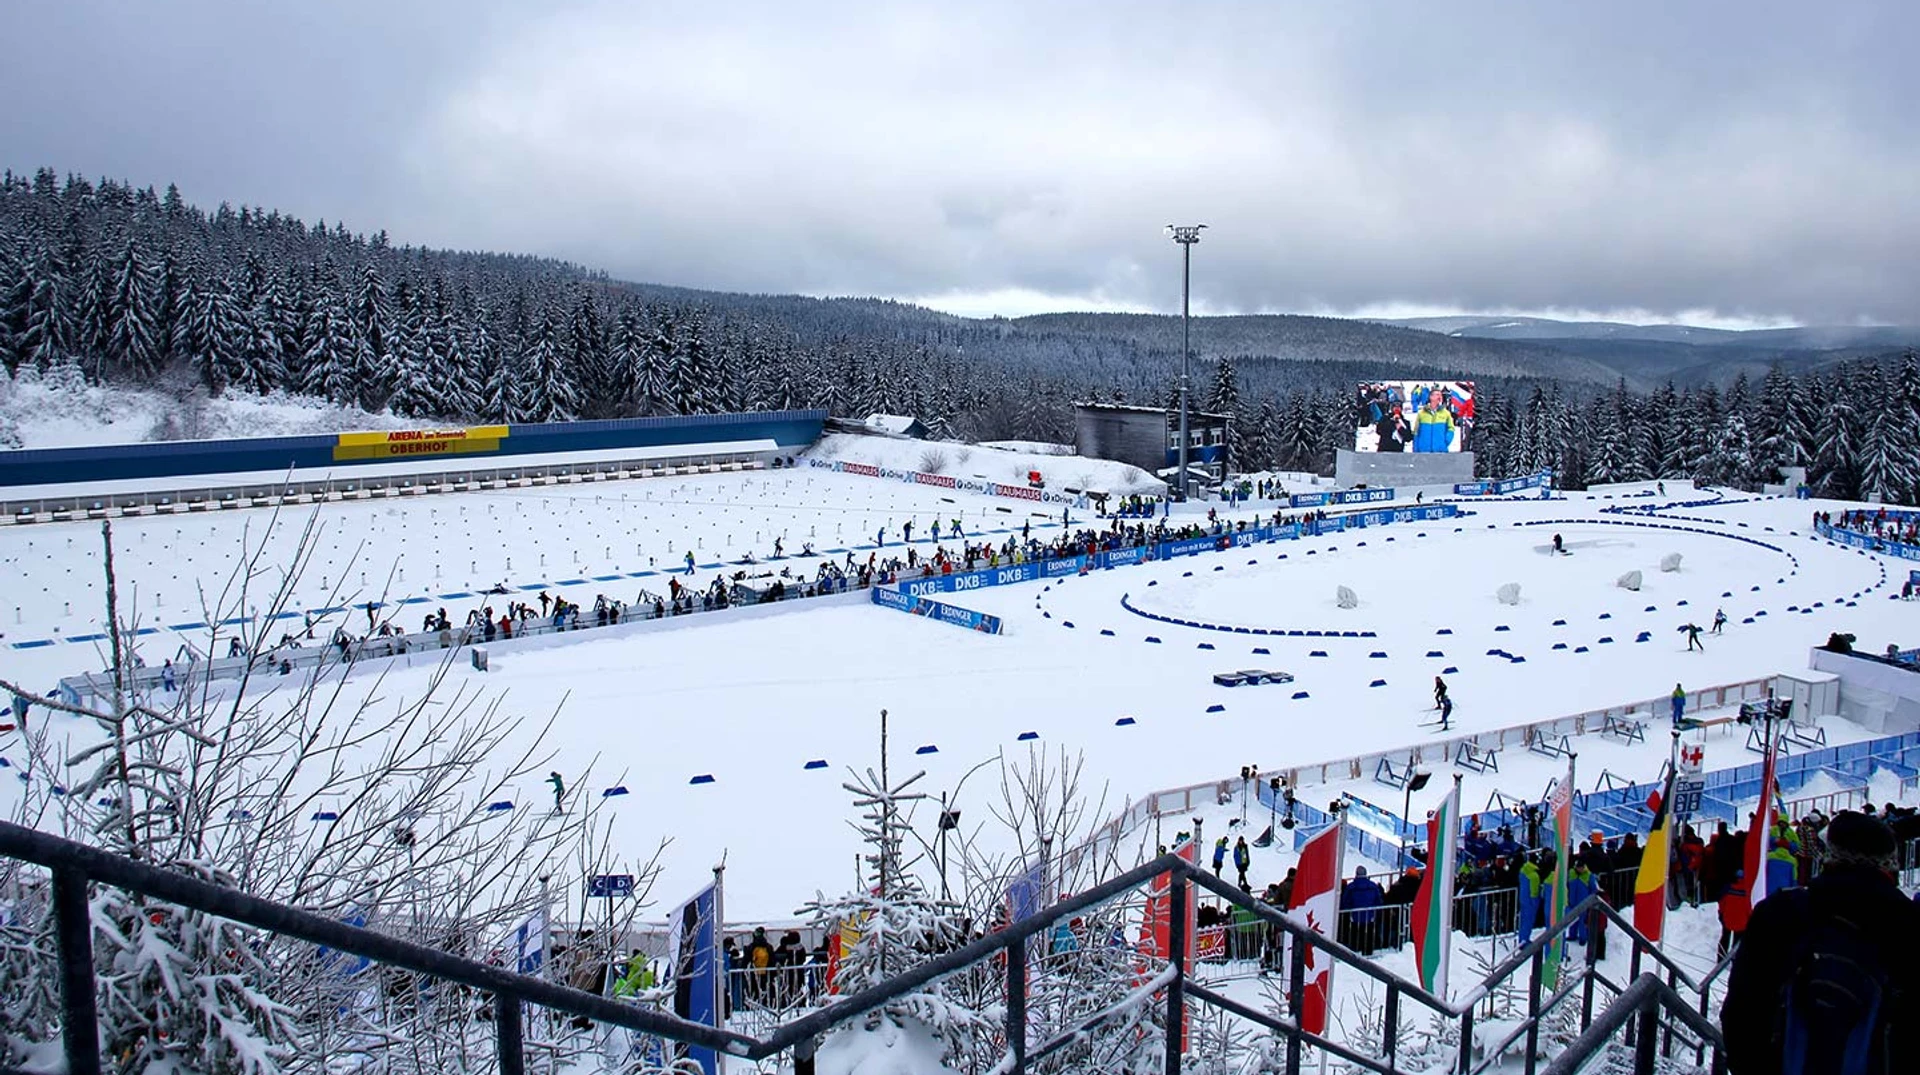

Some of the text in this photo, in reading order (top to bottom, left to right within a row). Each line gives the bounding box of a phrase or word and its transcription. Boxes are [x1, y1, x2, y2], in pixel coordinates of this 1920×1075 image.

[388, 431, 422, 441] ARENA
[390, 442, 448, 454] OBERHOF
[1345, 493, 1362, 502] DKB
[1369, 491, 1386, 500] DKB
[1393, 511, 1412, 521] DKB
[1425, 508, 1443, 518] DKB
[1364, 514, 1380, 525] DKB
[1236, 533, 1254, 546] DKB
[998, 568, 1022, 584] DKB
[955, 575, 979, 590] DKB
[910, 581, 935, 597] DKB
[940, 604, 972, 622] ERDINGER
[596, 879, 604, 888] C
[617, 879, 625, 887] D
